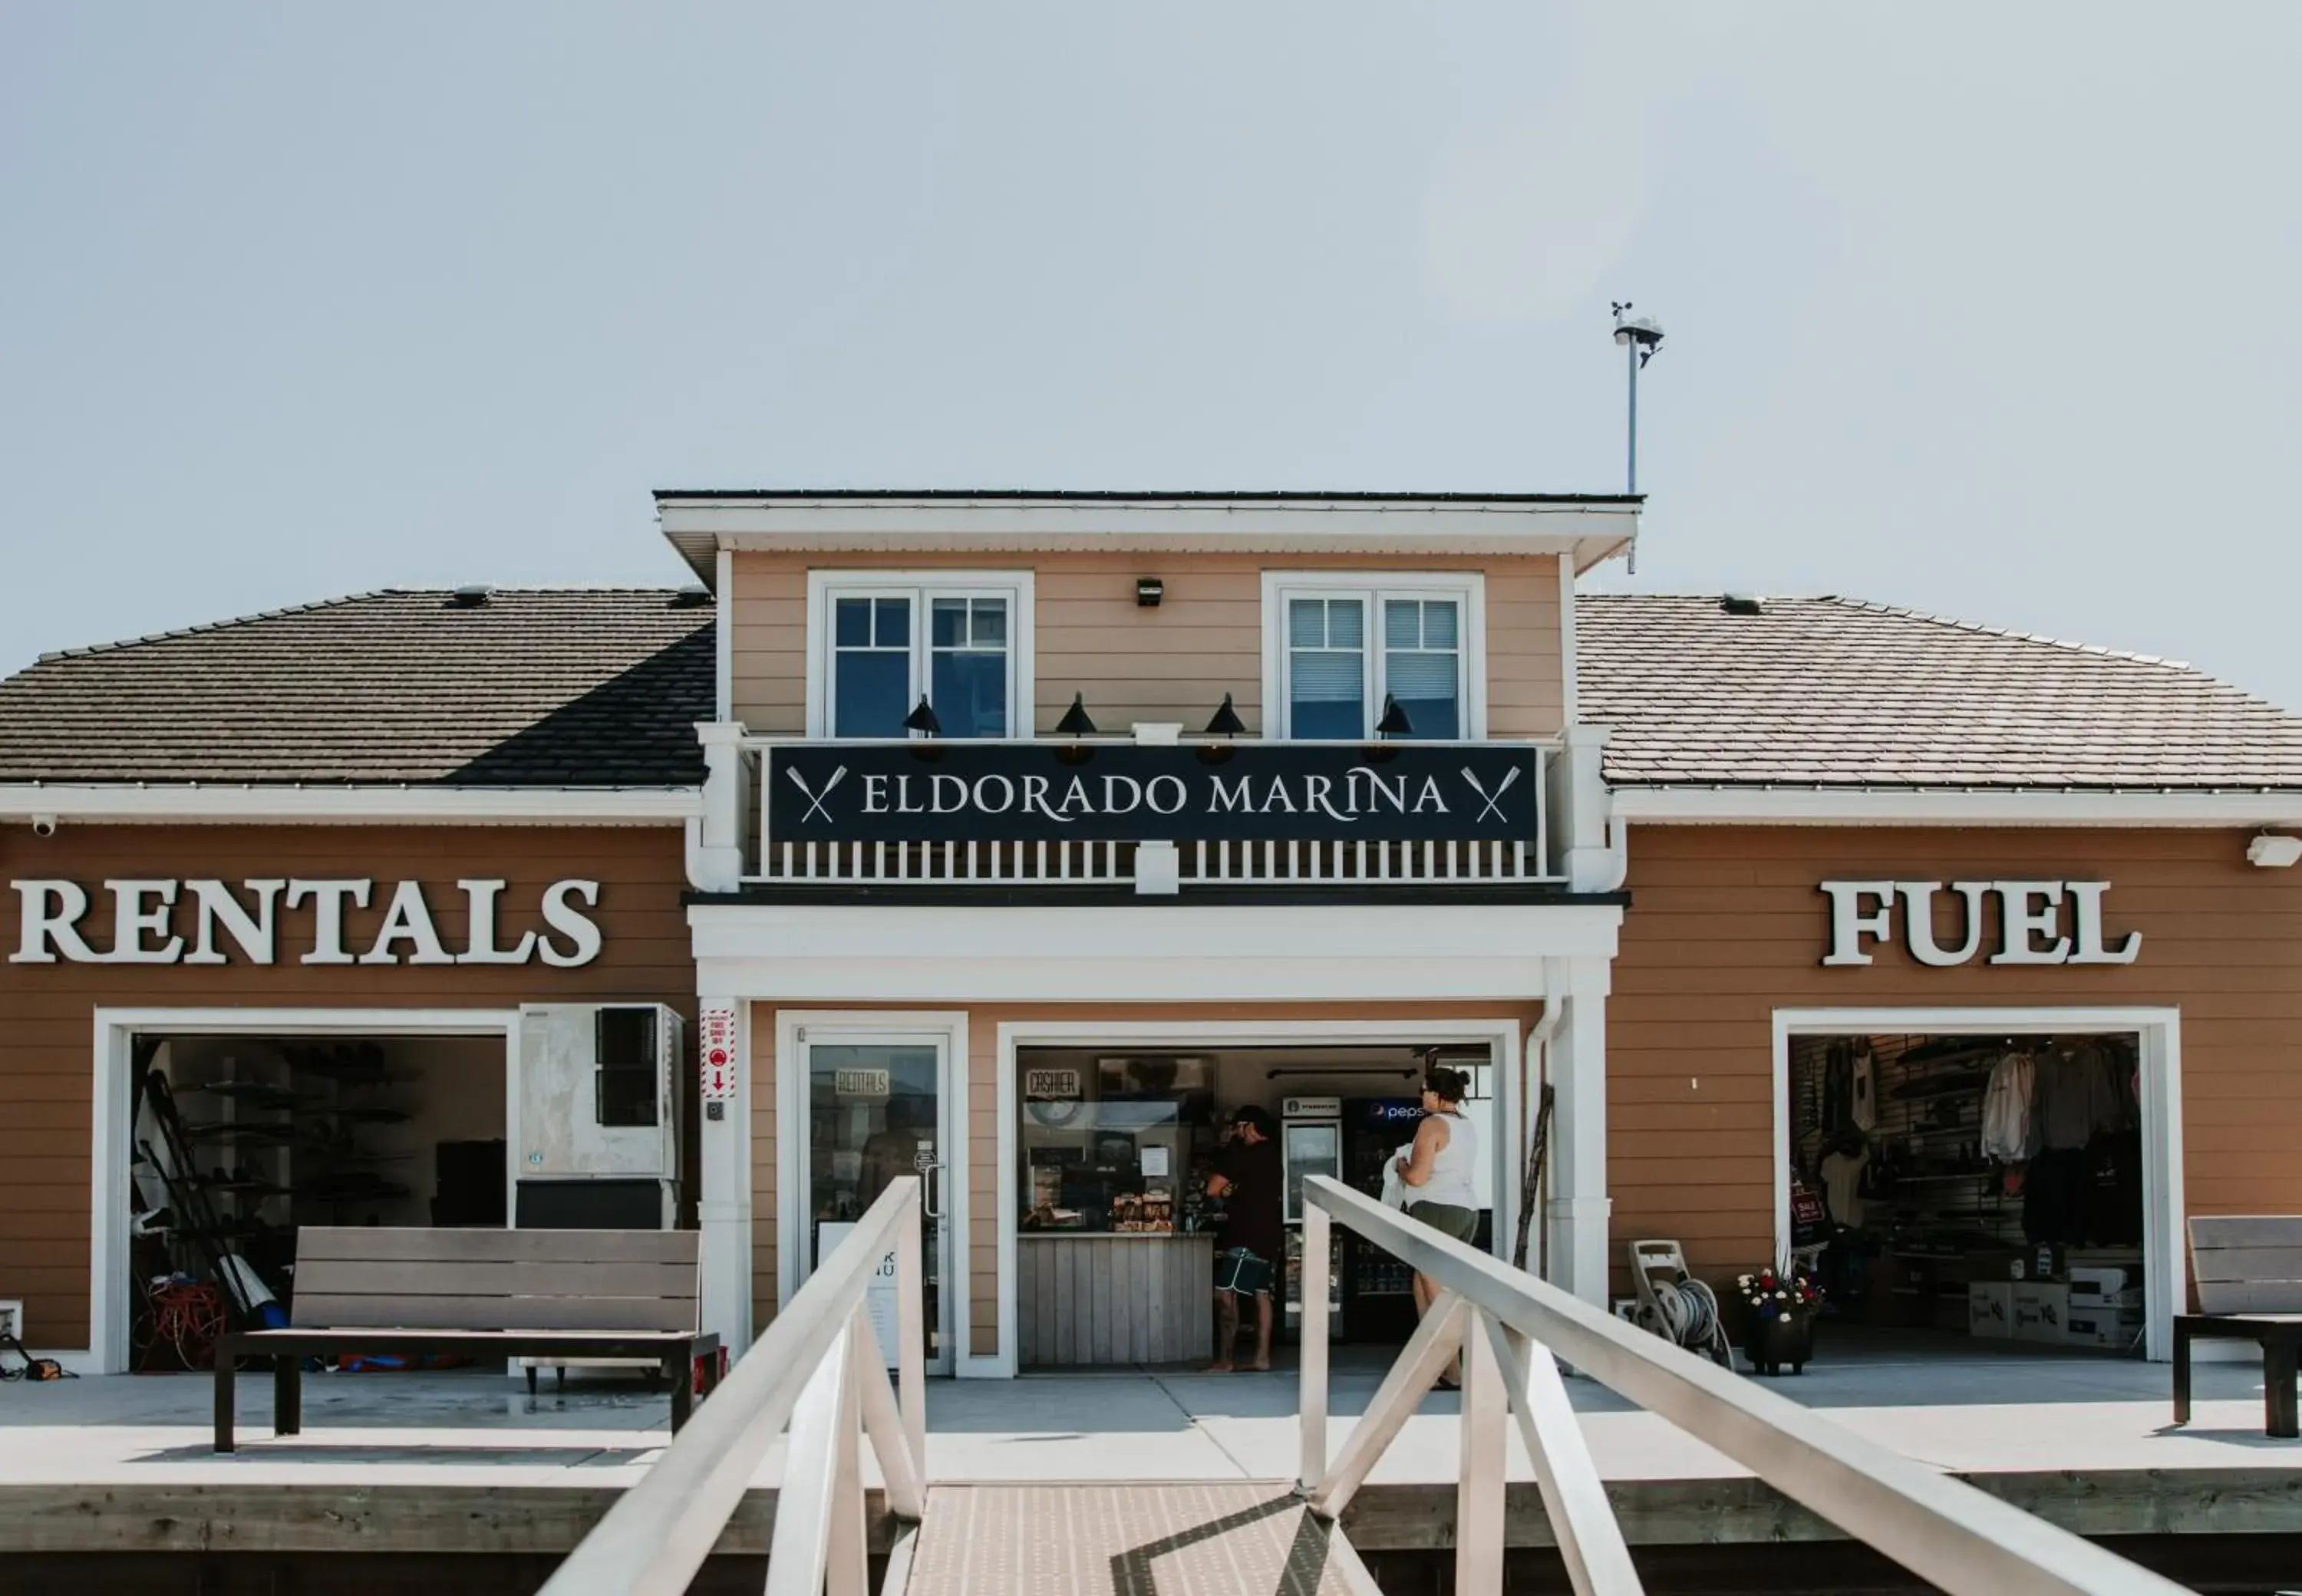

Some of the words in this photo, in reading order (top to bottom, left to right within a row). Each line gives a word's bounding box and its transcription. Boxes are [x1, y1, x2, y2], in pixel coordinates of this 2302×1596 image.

[860, 773, 1188, 822] ELDORADO
[1206, 767, 1450, 822] MARINA
[8, 879, 602, 967] RENTALS
[1819, 880, 2142, 967] FUEL
[838, 1071, 888, 1093] RENTALS
[1030, 1072, 1075, 1093] CASHIER
[1388, 1107, 1425, 1121] peps
